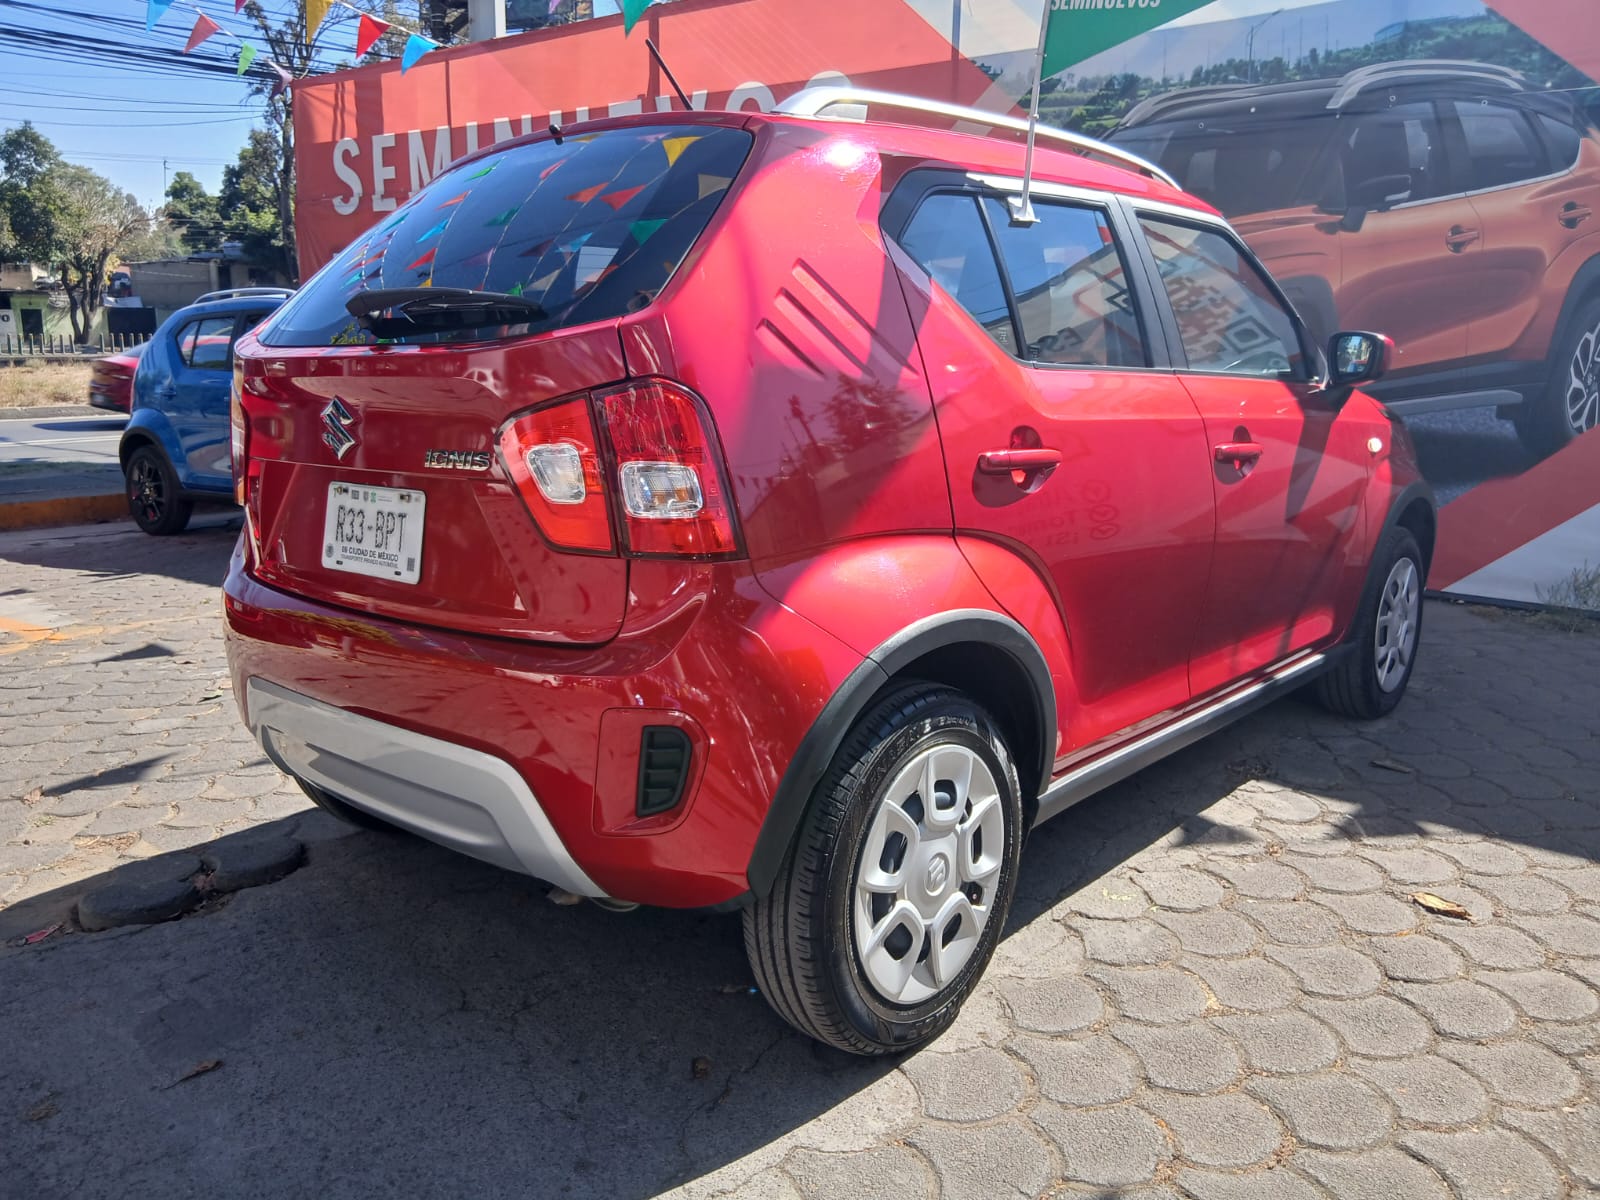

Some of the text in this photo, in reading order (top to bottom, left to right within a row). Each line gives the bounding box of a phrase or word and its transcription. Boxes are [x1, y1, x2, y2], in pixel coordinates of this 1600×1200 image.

[424, 448, 490, 471] IGNIS
[335, 504, 408, 552] R33-BPT
[348, 546, 369, 557] CIUDAD
[369, 550, 377, 559] DE
